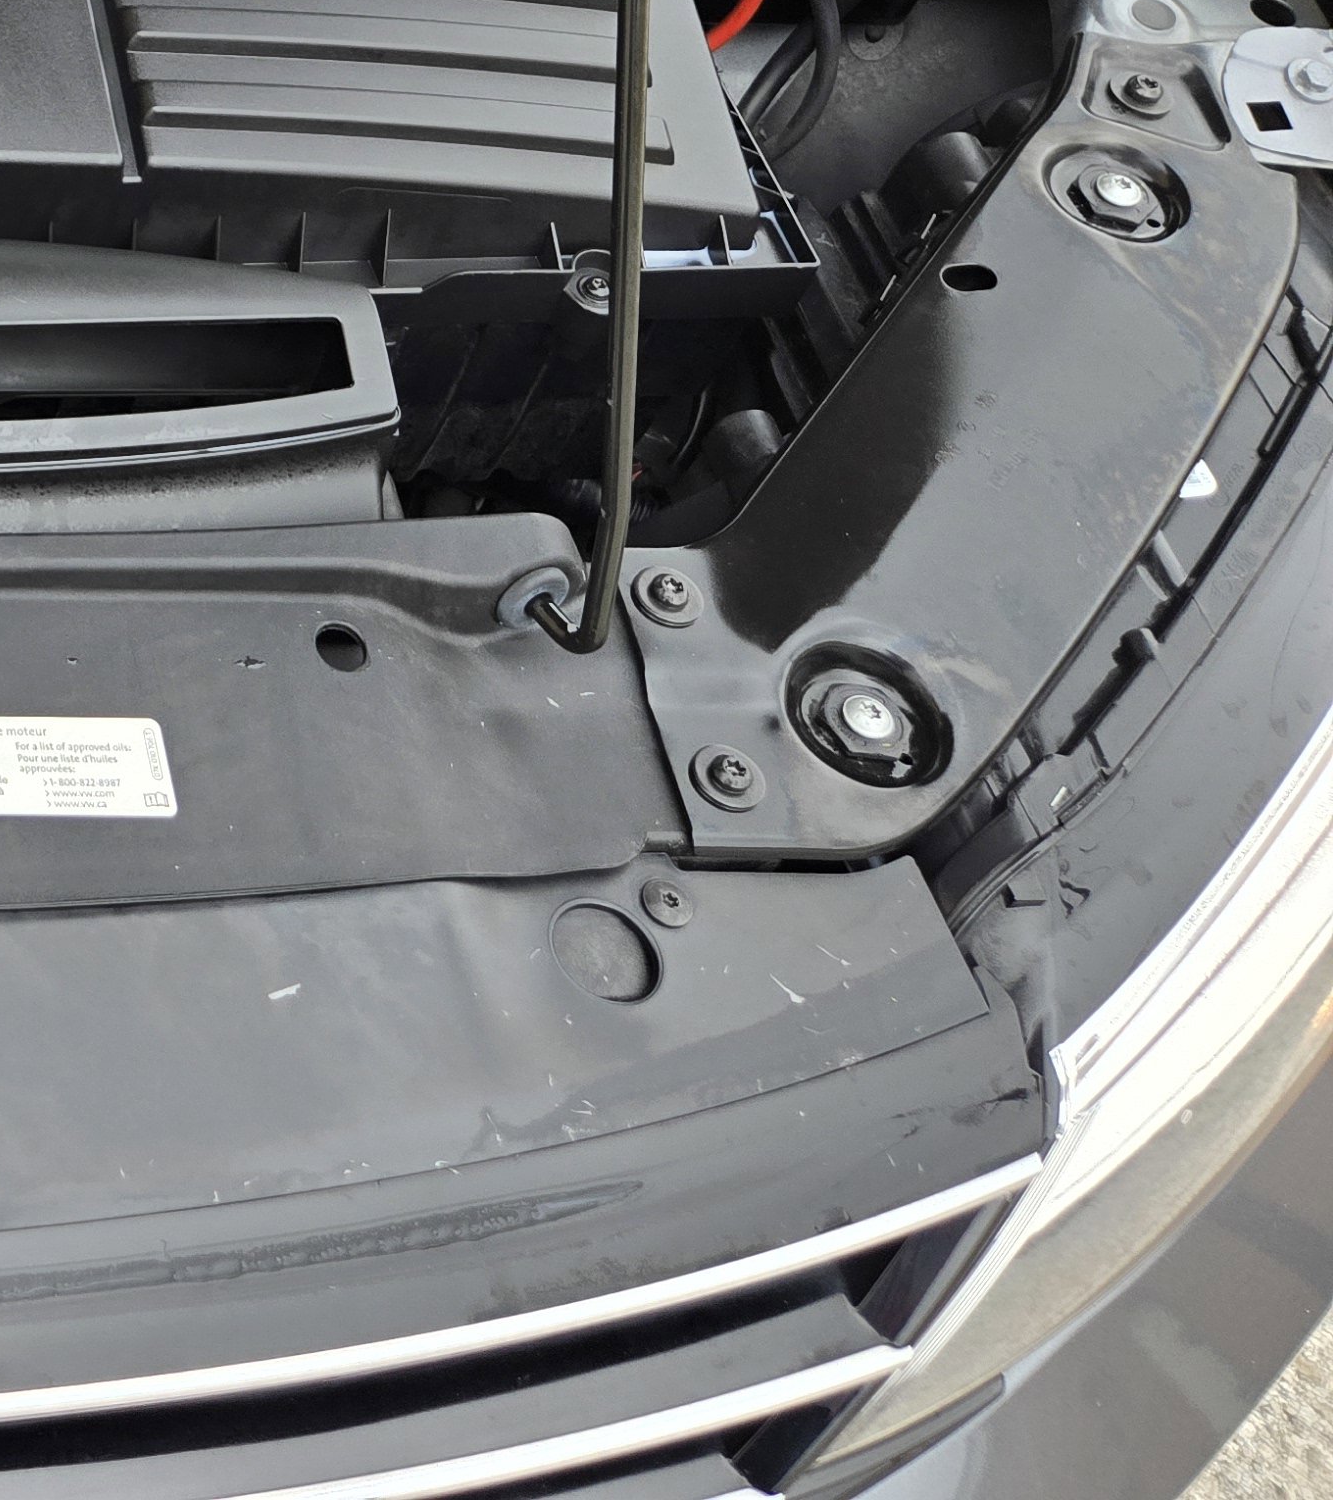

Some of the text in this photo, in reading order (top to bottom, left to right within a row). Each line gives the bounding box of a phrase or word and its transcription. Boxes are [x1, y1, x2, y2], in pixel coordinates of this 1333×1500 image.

[6, 726, 47, 736] moteur
[15, 742, 29, 751] For
[40, 742, 54, 751] list
[56, 742, 66, 751] of
[68, 743, 111, 753] approved
[17, 754, 39, 763] Pour
[61, 755, 80, 763] liste
